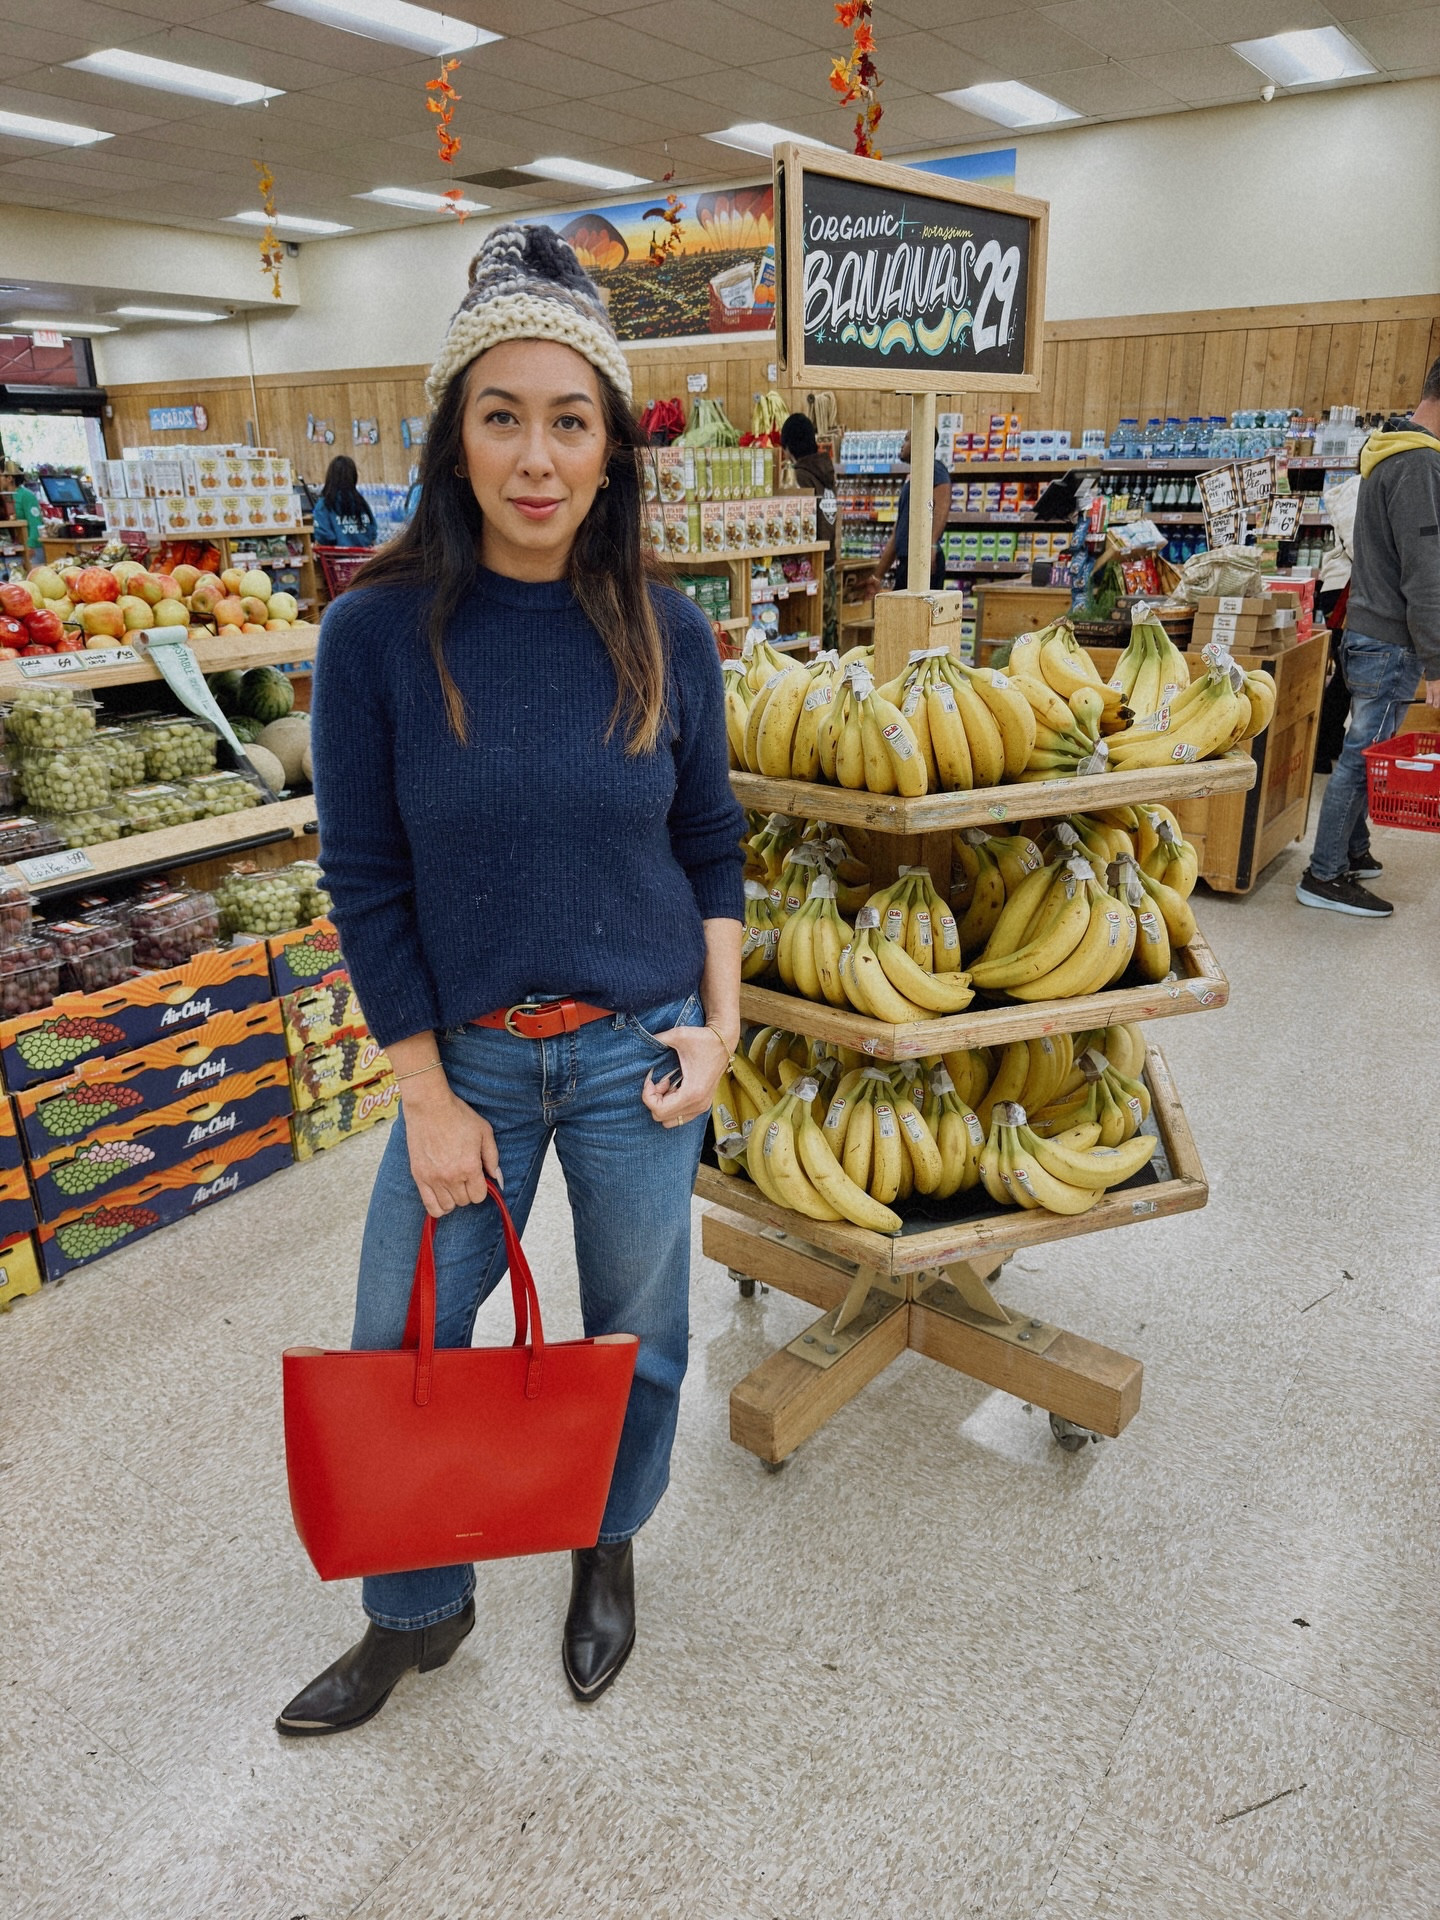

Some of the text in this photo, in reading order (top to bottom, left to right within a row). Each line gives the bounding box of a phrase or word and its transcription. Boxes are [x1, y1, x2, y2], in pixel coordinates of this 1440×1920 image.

[810, 210, 899, 241] ORGANIC
[804, 240, 976, 334] BANANAS
[860, 465, 875, 473] PLAIN
[1275, 500, 1298, 509] PUMPKIN
[885, 725, 899, 737] Dole
